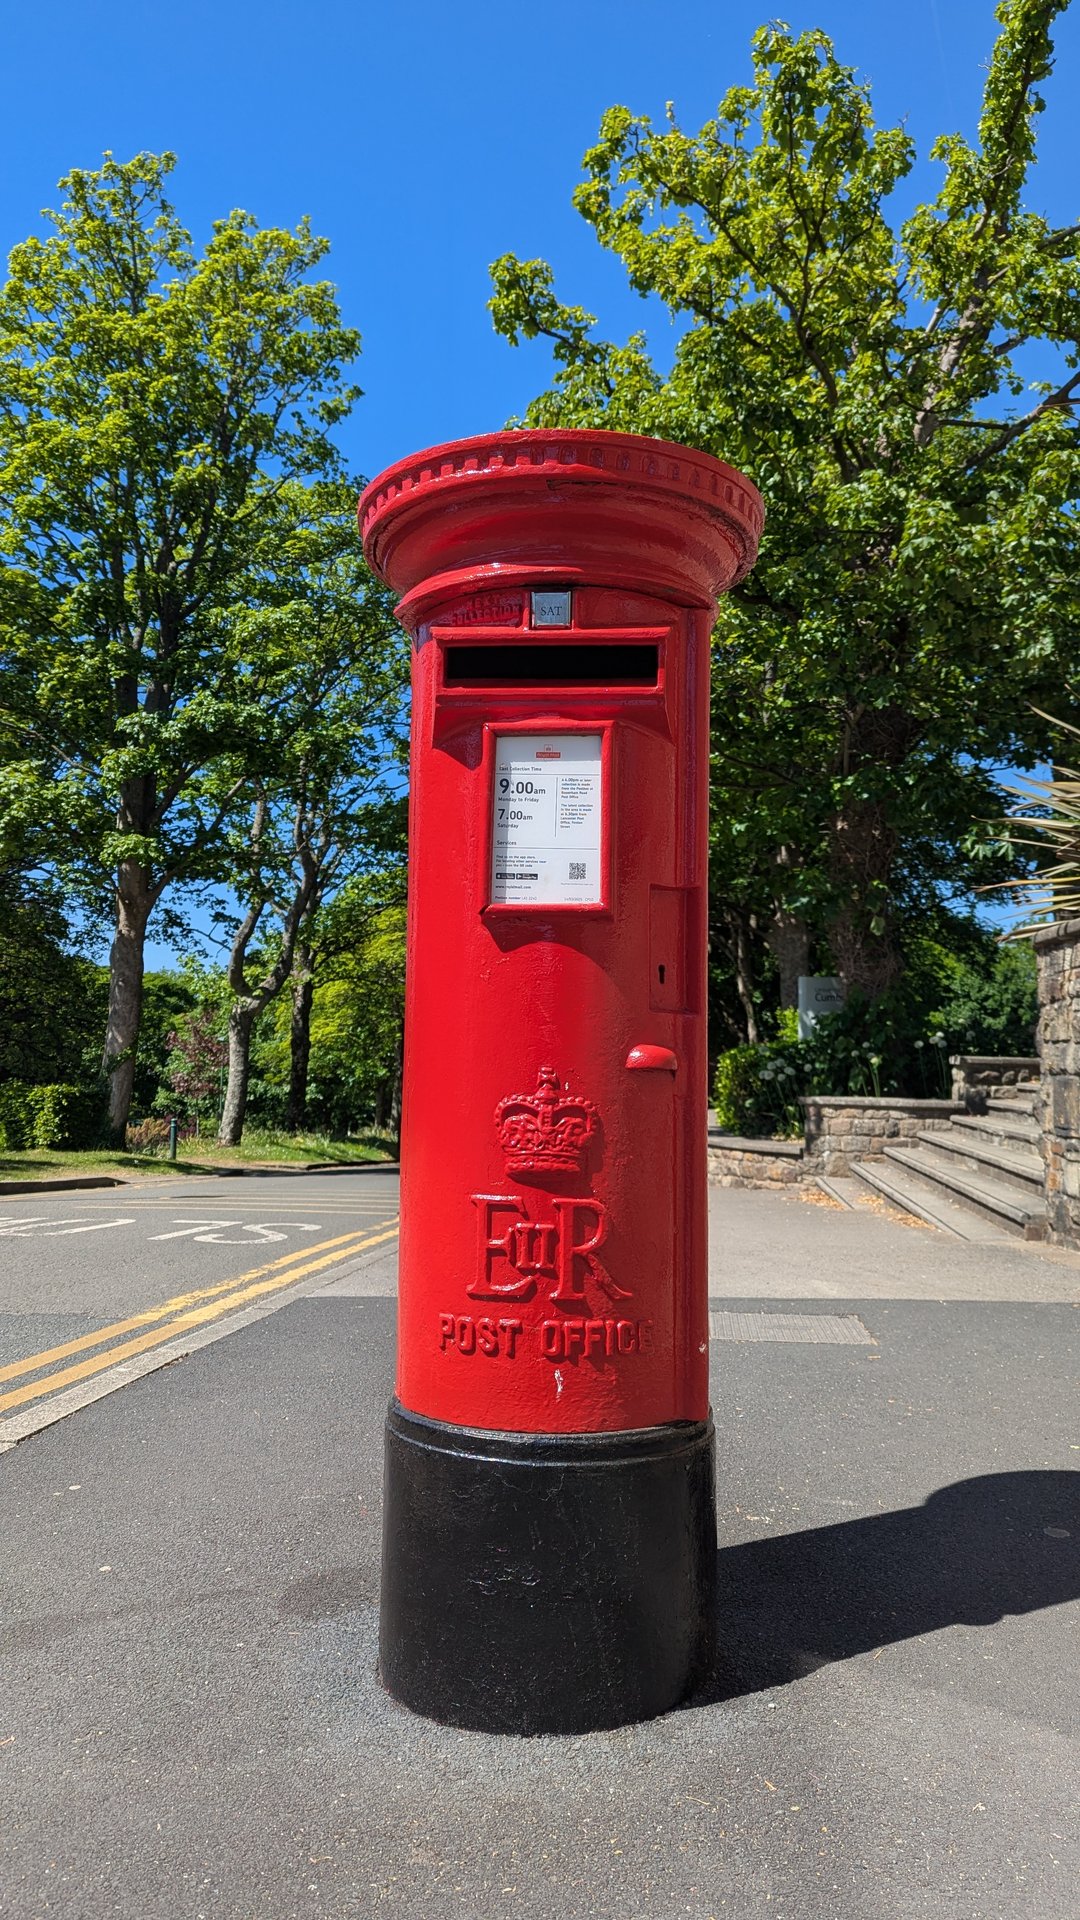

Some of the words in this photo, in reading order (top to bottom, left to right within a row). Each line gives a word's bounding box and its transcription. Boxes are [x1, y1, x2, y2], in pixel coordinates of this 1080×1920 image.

[540, 606, 562, 616] SAT
[499, 778, 546, 794] 9.00am
[498, 808, 533, 820] 7.00am
[438, 1312, 523, 1356] POST
[540, 1318, 654, 1357] OFFICE
